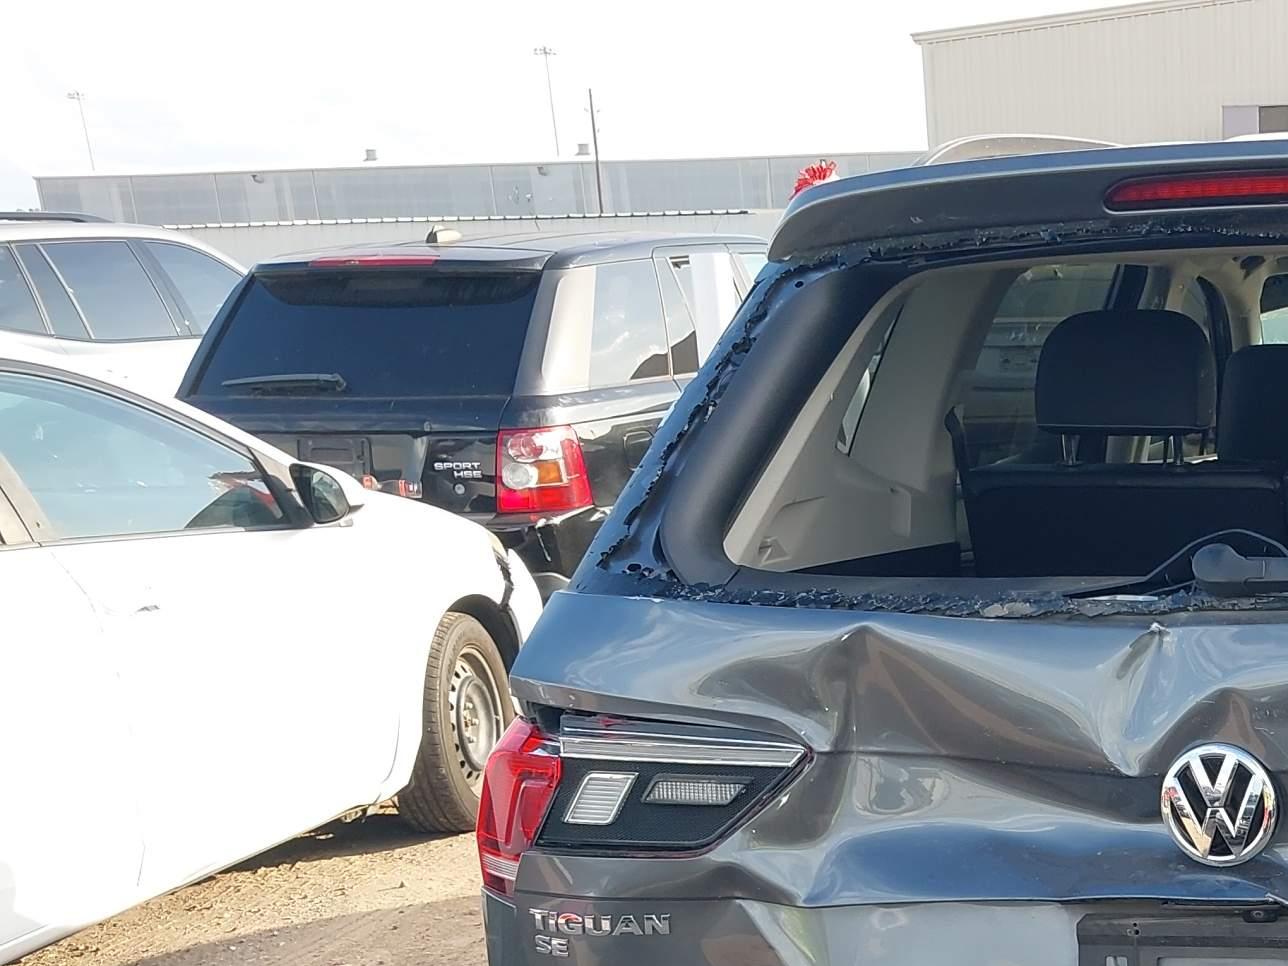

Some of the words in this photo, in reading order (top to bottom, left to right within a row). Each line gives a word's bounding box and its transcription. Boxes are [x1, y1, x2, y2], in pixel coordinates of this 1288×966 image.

[434, 462, 481, 471] SPORT
[454, 471, 483, 479] HSE
[1161, 742, 1276, 867] VW
[535, 934, 569, 957] SE
